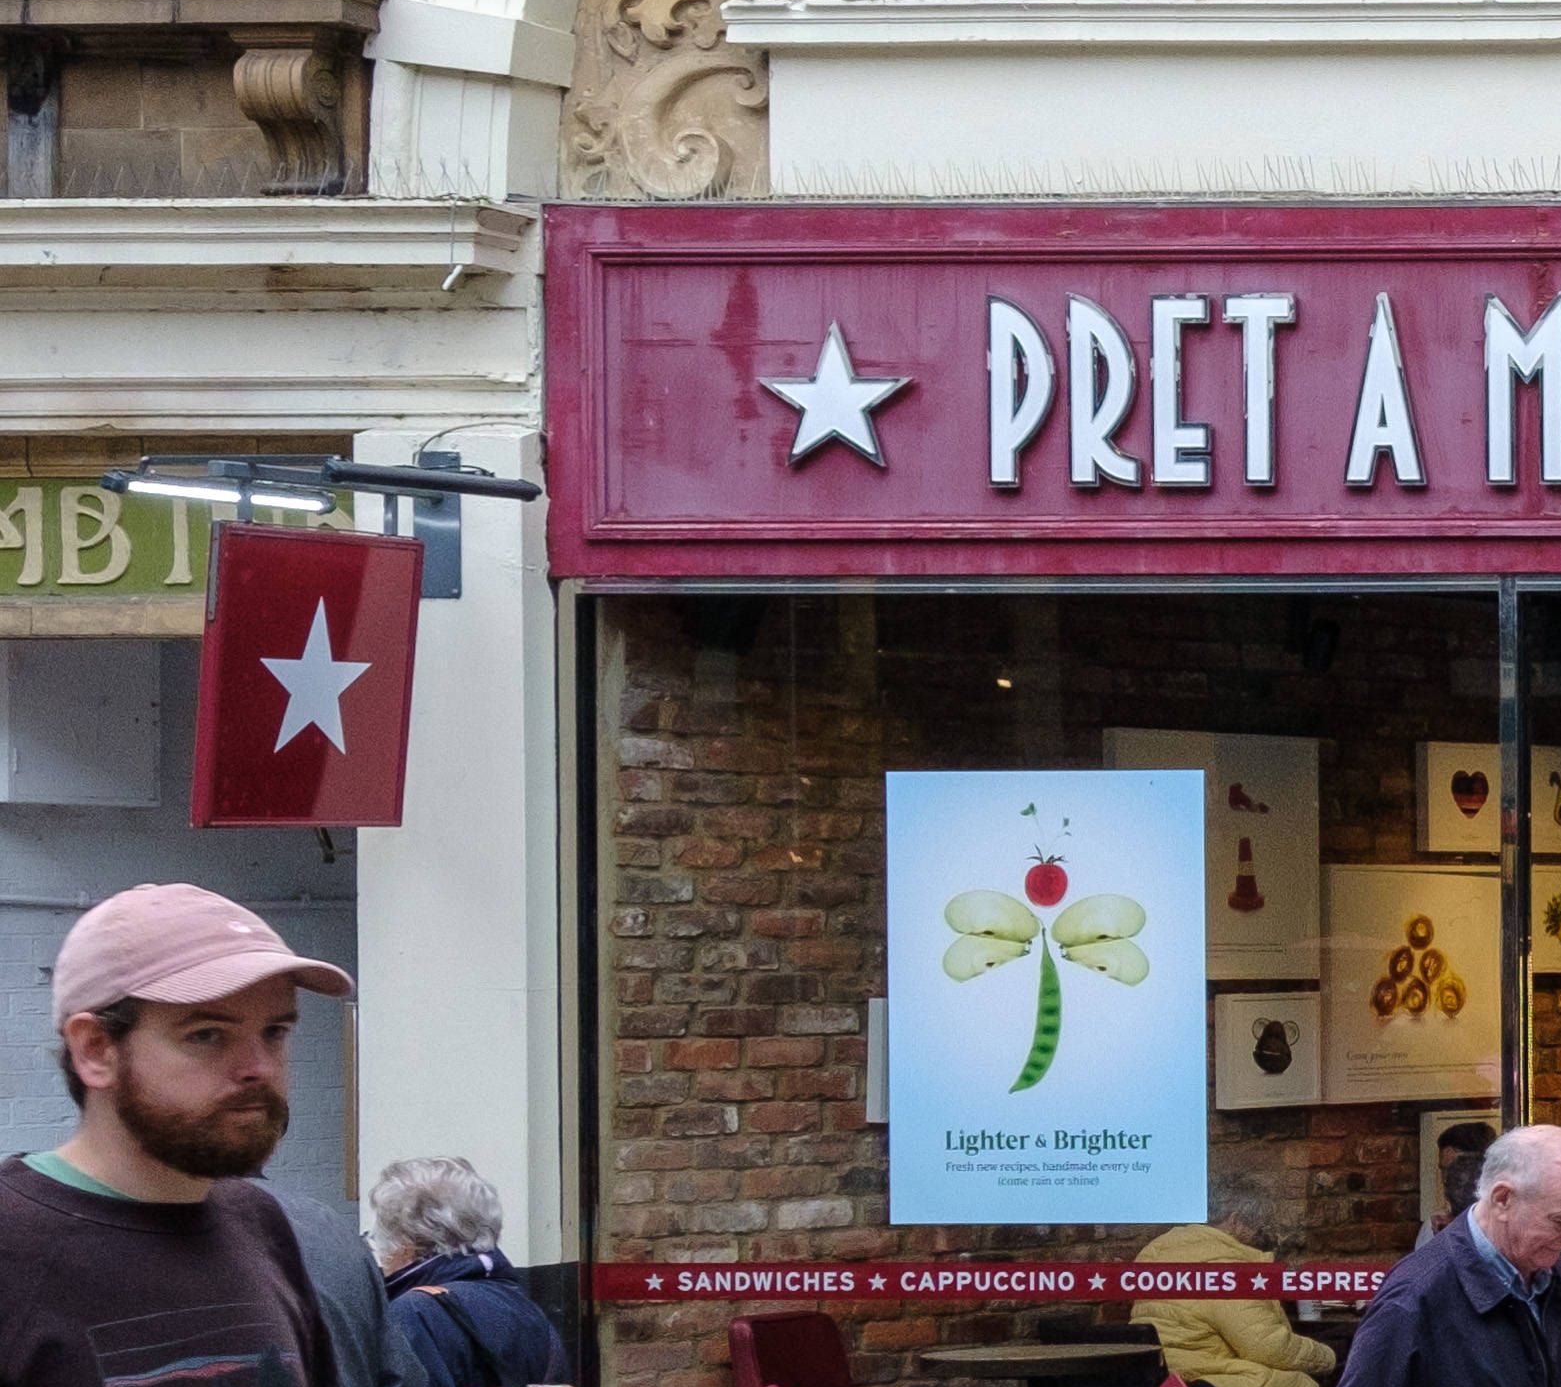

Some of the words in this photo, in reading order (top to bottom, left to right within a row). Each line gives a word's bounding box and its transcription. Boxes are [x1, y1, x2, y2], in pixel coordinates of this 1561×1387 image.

[986, 288, 1298, 490] PRET
[1345, 289, 1428, 488] A
[946, 1129, 1030, 1155] Lighter
[1035, 1134, 1047, 1149] &
[1054, 1129, 1152, 1155] Brighter
[946, 1162, 974, 1172] Fresh
[1042, 1162, 1098, 1171] handmade
[1100, 1163, 1129, 1174] every
[1132, 1162, 1151, 1173] day
[998, 1176, 1028, 1186] (come
[1031, 1176, 1051, 1186] rain
[677, 1271, 855, 1292] SANDWICHES
[900, 1271, 1075, 1292] CAPPUCCINO
[1120, 1271, 1237, 1291] COOKIES
